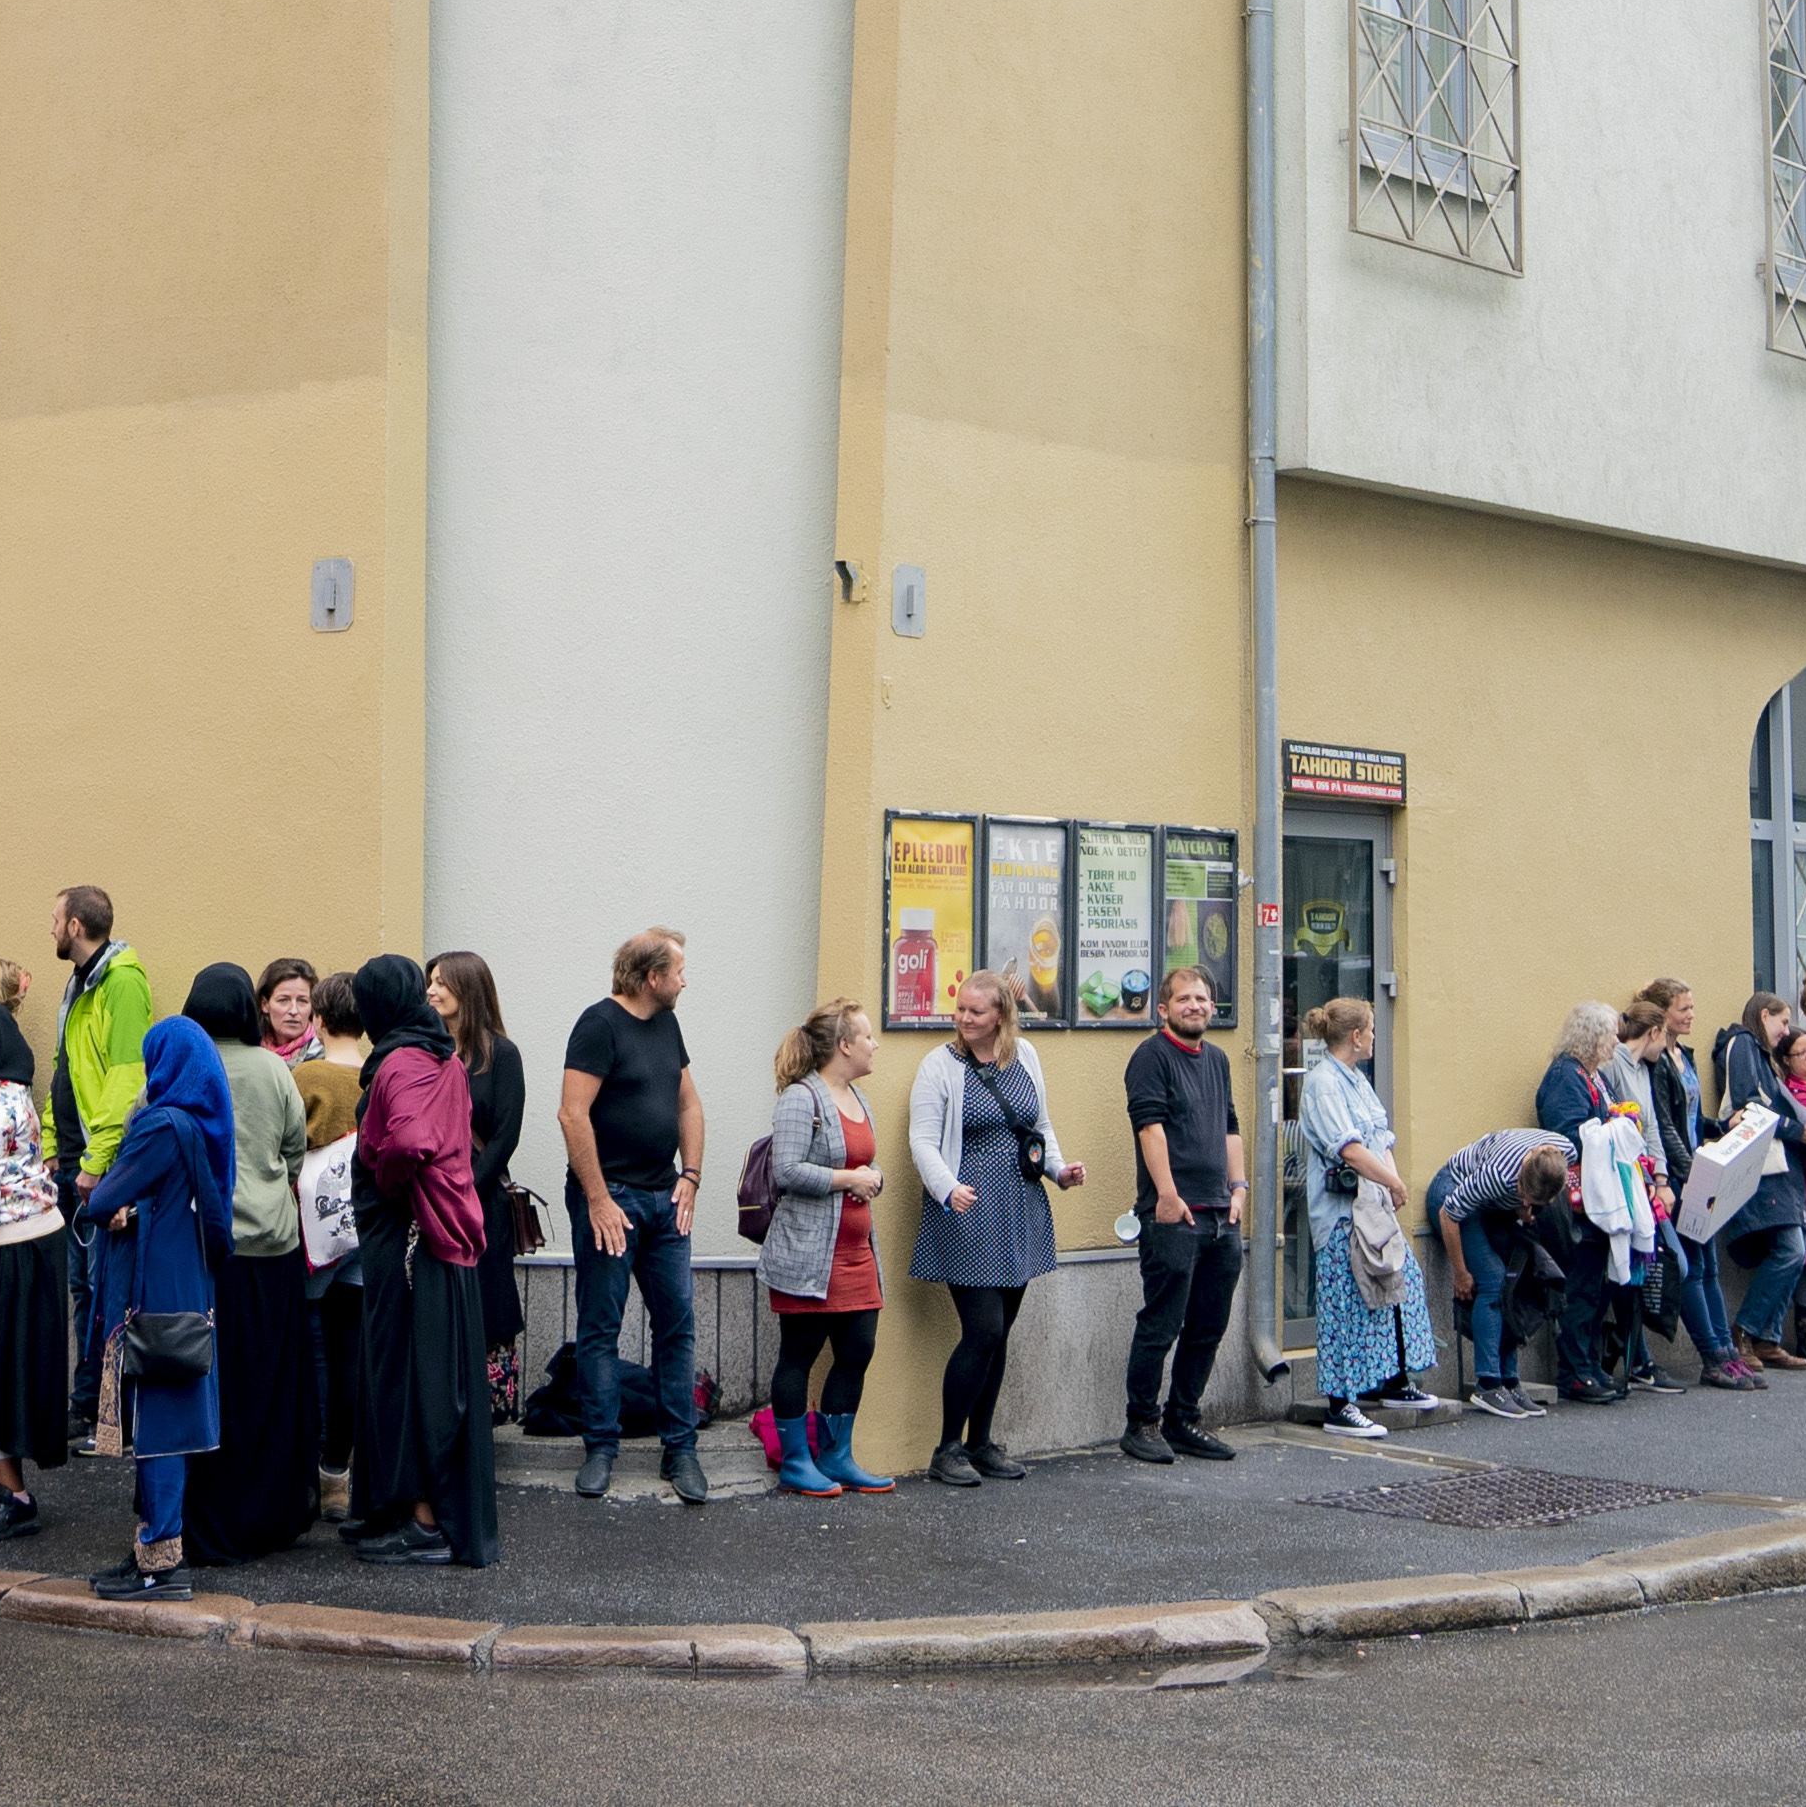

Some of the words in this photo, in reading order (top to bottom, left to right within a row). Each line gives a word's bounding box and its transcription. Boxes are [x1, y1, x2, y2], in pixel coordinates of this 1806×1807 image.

[1289, 754, 1352, 779] TAHOOR
[1356, 762, 1402, 785] STORE
[1315, 780, 1330, 791] OSS
[1331, 780, 1341, 793] PÅ
[1080, 834, 1110, 844] SLITER
[1113, 835, 1125, 844] DU
[894, 842, 967, 865] EPLEEDDIK
[992, 837, 1058, 863] EKTE
[1080, 846, 1100, 856] NOE
[1102, 847, 1114, 856] AV
[1117, 847, 1147, 857] DETTE?
[1166, 839, 1214, 855] MATCHA
[1217, 842, 1230, 856] TE
[991, 862, 1058, 878] HONNING
[1087, 869, 1114, 881] TØRR
[1118, 870, 1137, 881] HUD
[1019, 881, 1034, 894] DU
[1038, 882, 1059, 896] HOS
[1087, 882, 1115, 892] AKNE
[992, 895, 1058, 911] TAHOOR
[1087, 894, 1124, 905] KVISER
[1087, 906, 1121, 916] EKSEM
[1087, 918, 1138, 929] PSORIASIS
[1080, 940, 1099, 948] KOM
[1102, 940, 1128, 948] INNOM
[1130, 940, 1149, 948] ELLER
[1080, 949, 1105, 958] BESØK
[1109, 949, 1149, 958] TAHOOR.NO
[898, 948, 929, 974] goli
